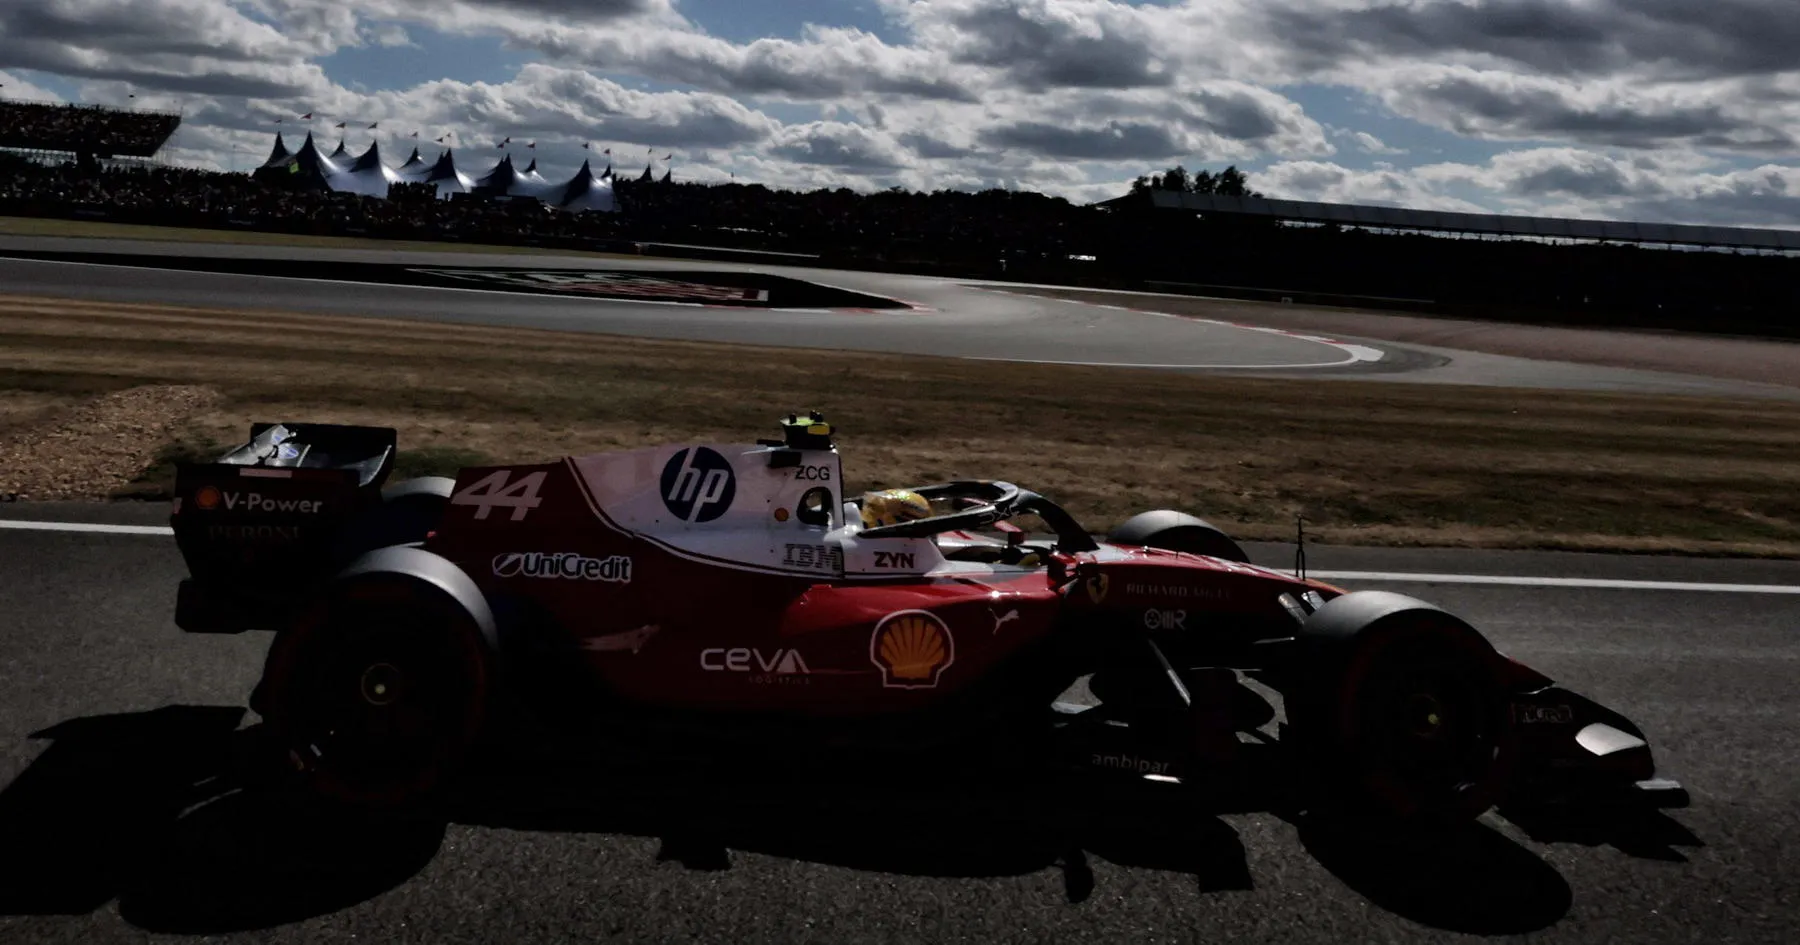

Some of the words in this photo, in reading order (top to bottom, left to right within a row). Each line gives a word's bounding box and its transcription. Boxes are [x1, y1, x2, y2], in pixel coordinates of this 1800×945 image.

[795, 465, 830, 481] ZCG
[451, 470, 548, 521] 44
[667, 447, 730, 523] hp
[223, 491, 324, 513] V-Power
[523, 553, 632, 582] UniCredit
[783, 544, 841, 569] IBM
[874, 552, 914, 568] ZYN
[1091, 753, 1169, 773] ambipar
